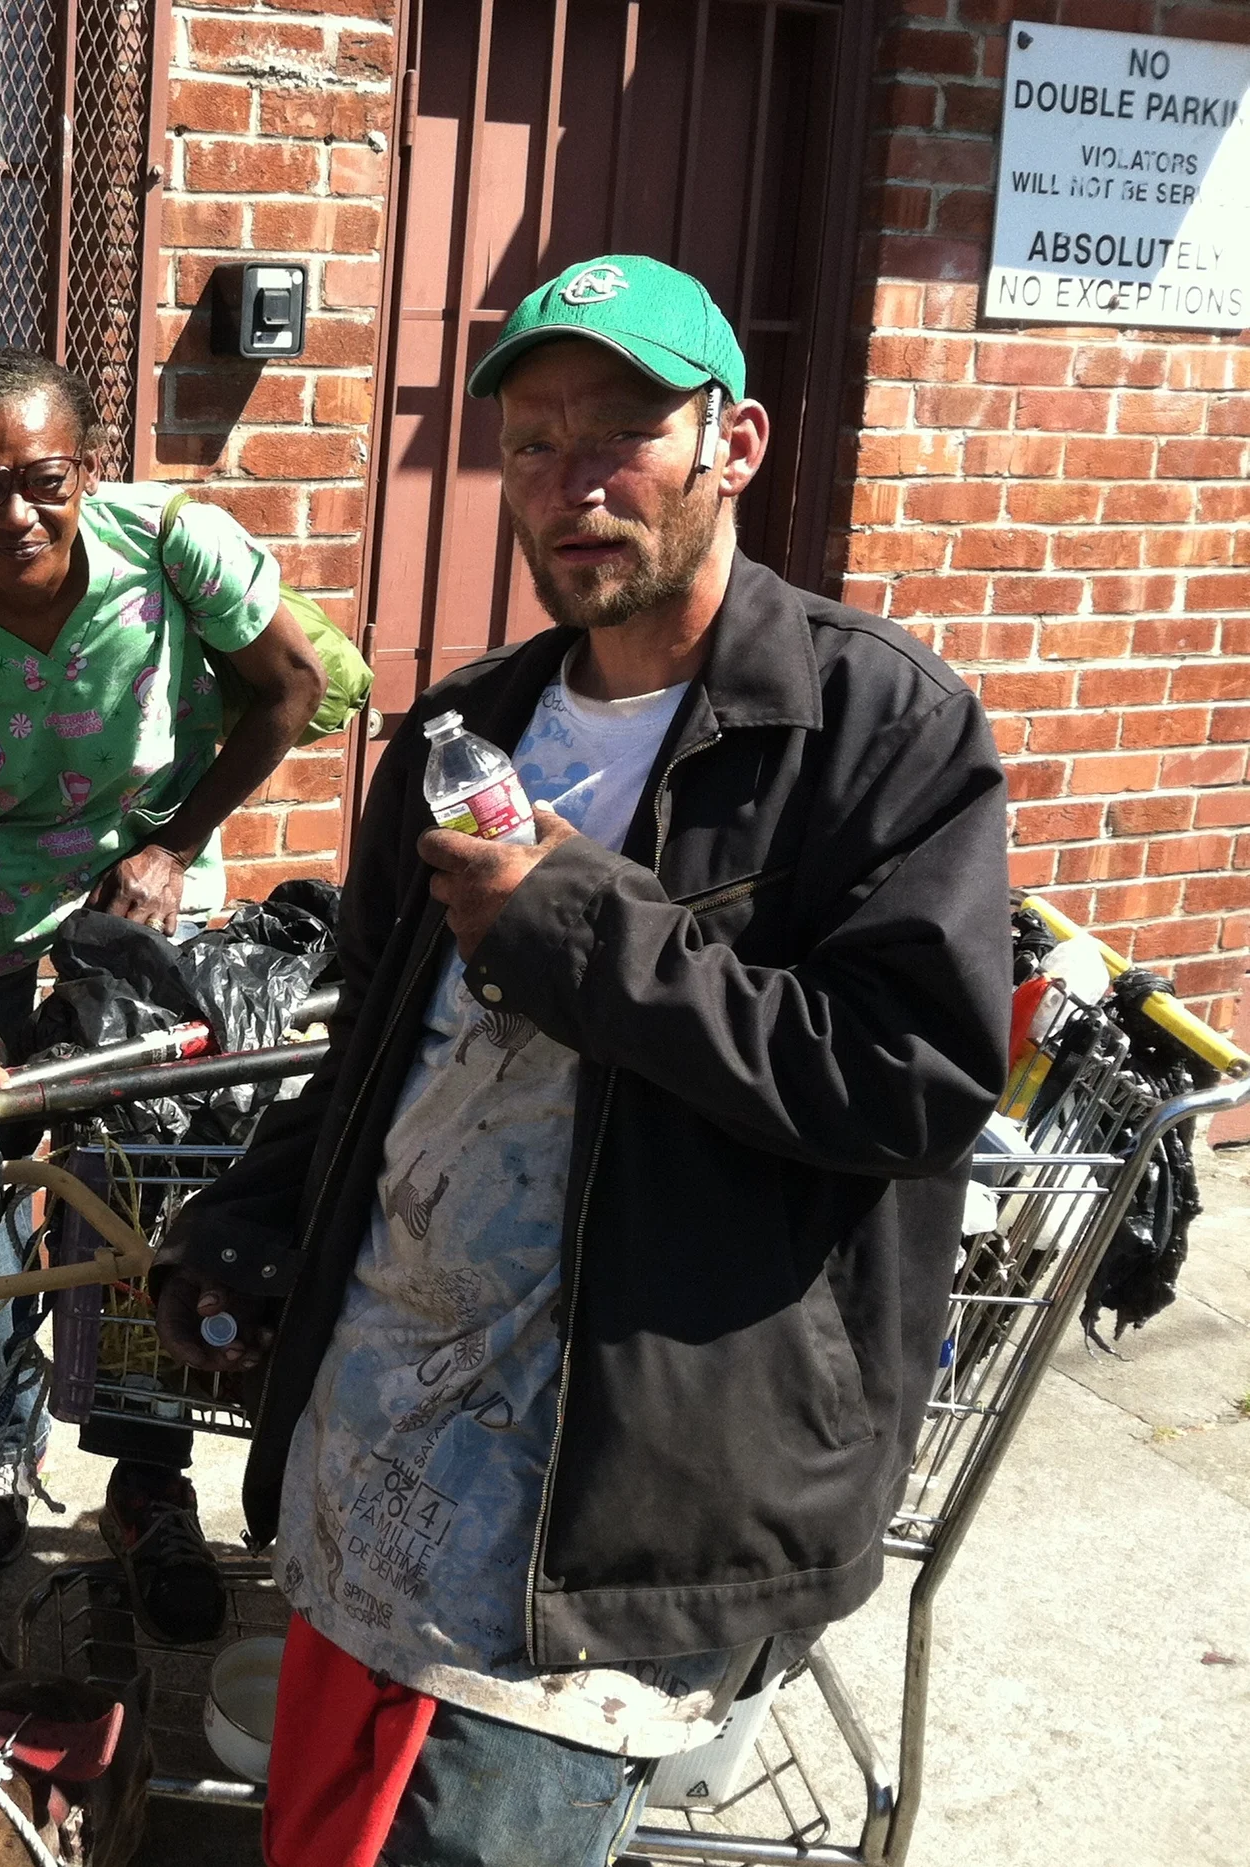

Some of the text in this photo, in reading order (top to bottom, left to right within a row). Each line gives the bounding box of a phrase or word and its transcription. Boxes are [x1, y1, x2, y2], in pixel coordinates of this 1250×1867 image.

[1129, 48, 1171, 81] NO
[1014, 79, 1136, 119] DOUBLE
[1081, 145, 1198, 175] VIOLATORS
[1012, 171, 1060, 197] WILL
[1070, 175, 1114, 200] NOT
[1122, 180, 1147, 202] BE
[1027, 230, 1224, 271] ABSOLUTELY
[1000, 275, 1243, 316] NO EXCEPTIONS
[384, 1457, 405, 1493] OF
[387, 1410, 457, 1518] ONE SAFARI
[358, 1482, 385, 1508] LA
[349, 1498, 435, 1567] FAMILLE
[417, 1501, 440, 1529] 4
